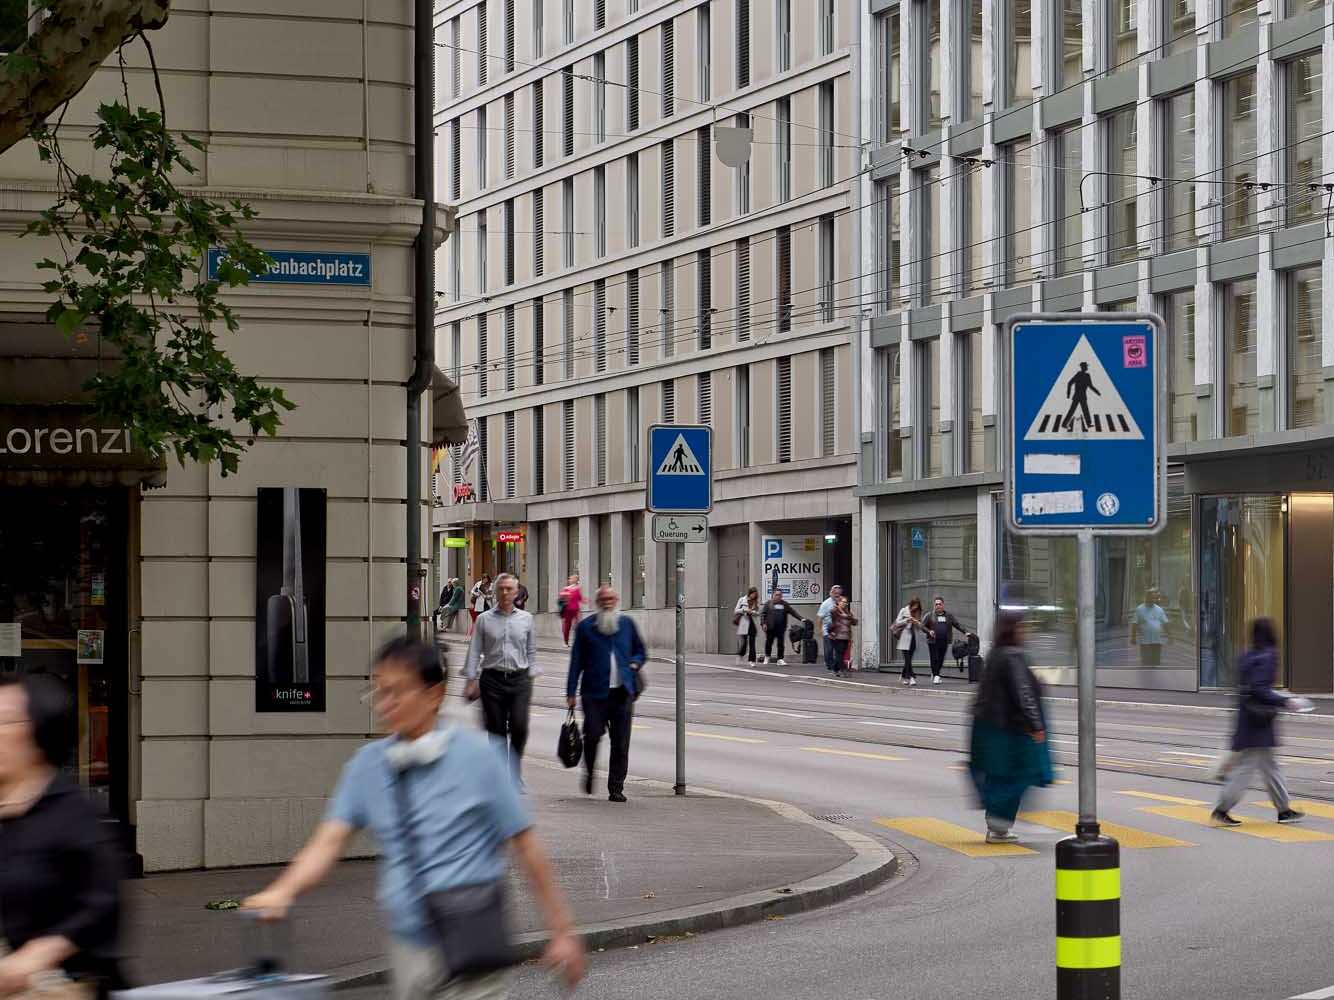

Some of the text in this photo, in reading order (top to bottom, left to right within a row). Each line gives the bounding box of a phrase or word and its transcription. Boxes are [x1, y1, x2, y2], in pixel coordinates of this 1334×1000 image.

[216, 255, 364, 280] Senbachplatz
[0, 423, 133, 455] orenzi
[660, 530, 688, 540] Querung
[764, 562, 821, 575] PARKING
